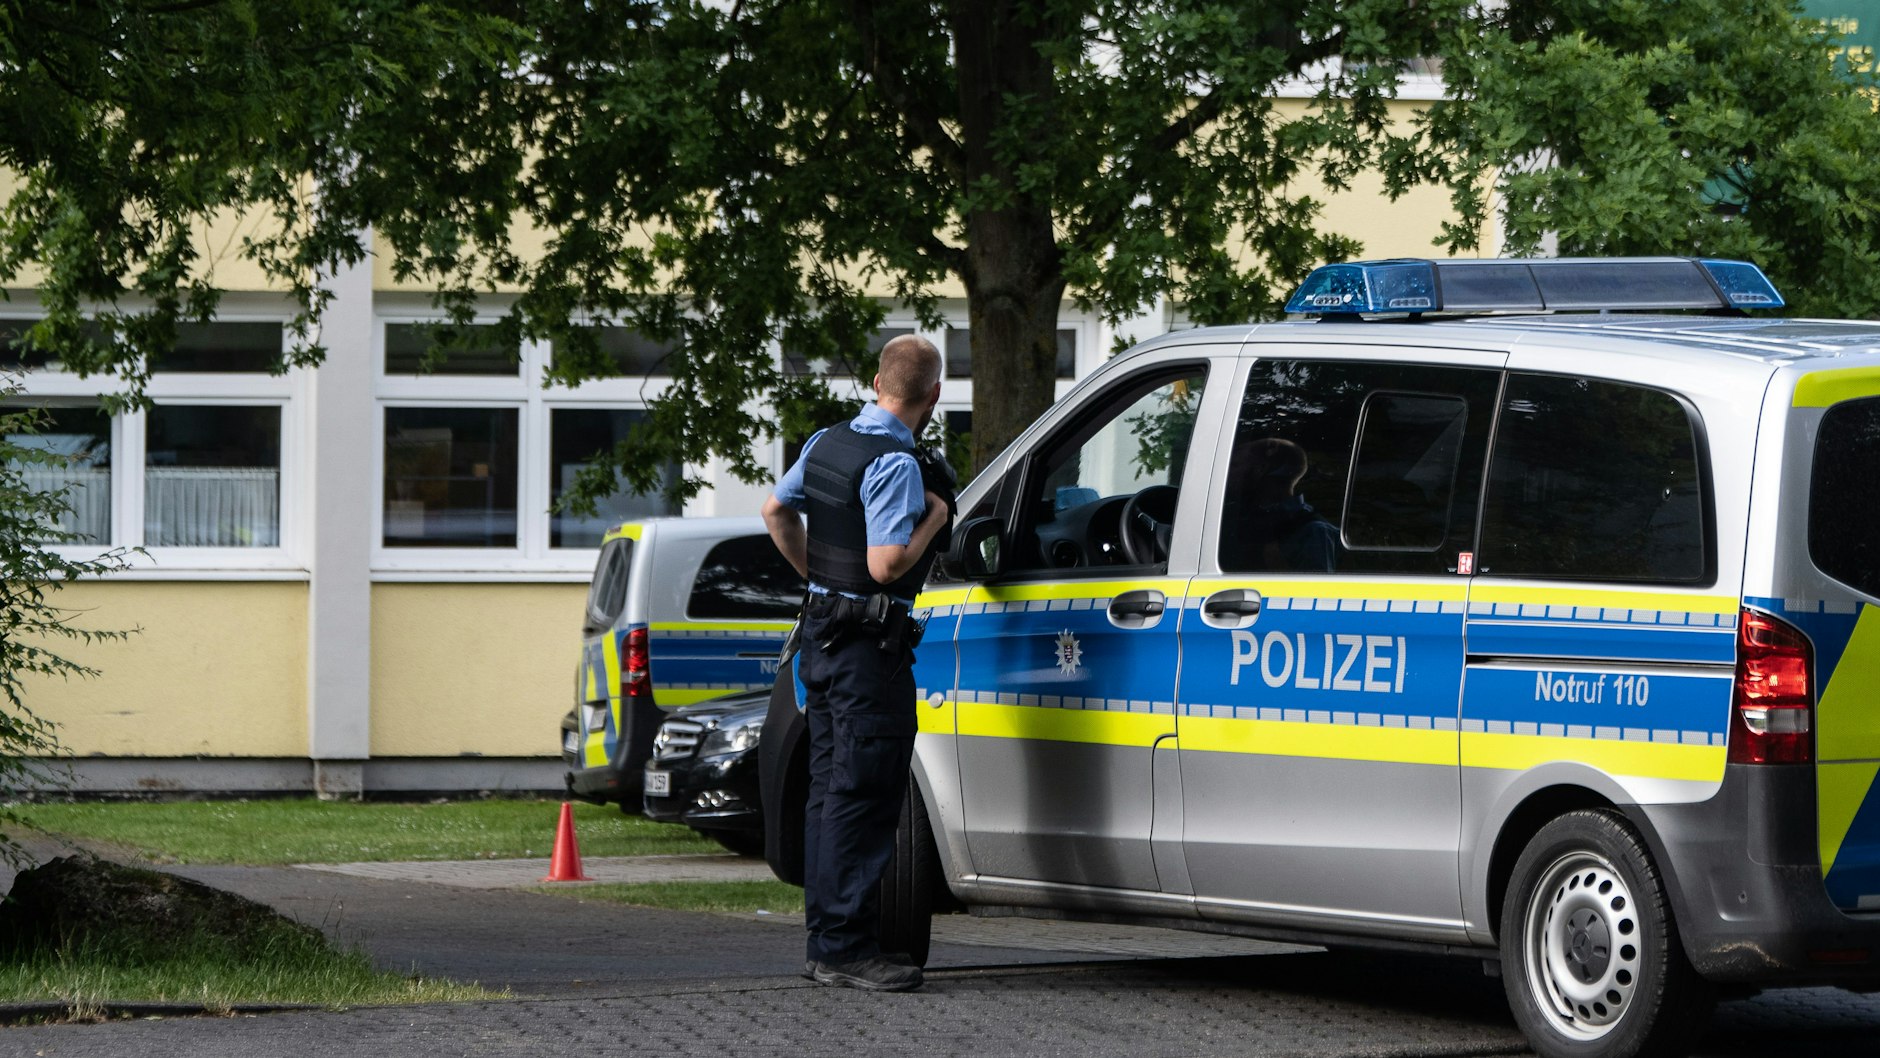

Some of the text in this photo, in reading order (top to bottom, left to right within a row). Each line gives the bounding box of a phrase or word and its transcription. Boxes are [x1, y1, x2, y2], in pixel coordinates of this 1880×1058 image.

[1230, 630, 1407, 693] POLIZEI
[1535, 671, 1649, 707] Notruf 110
